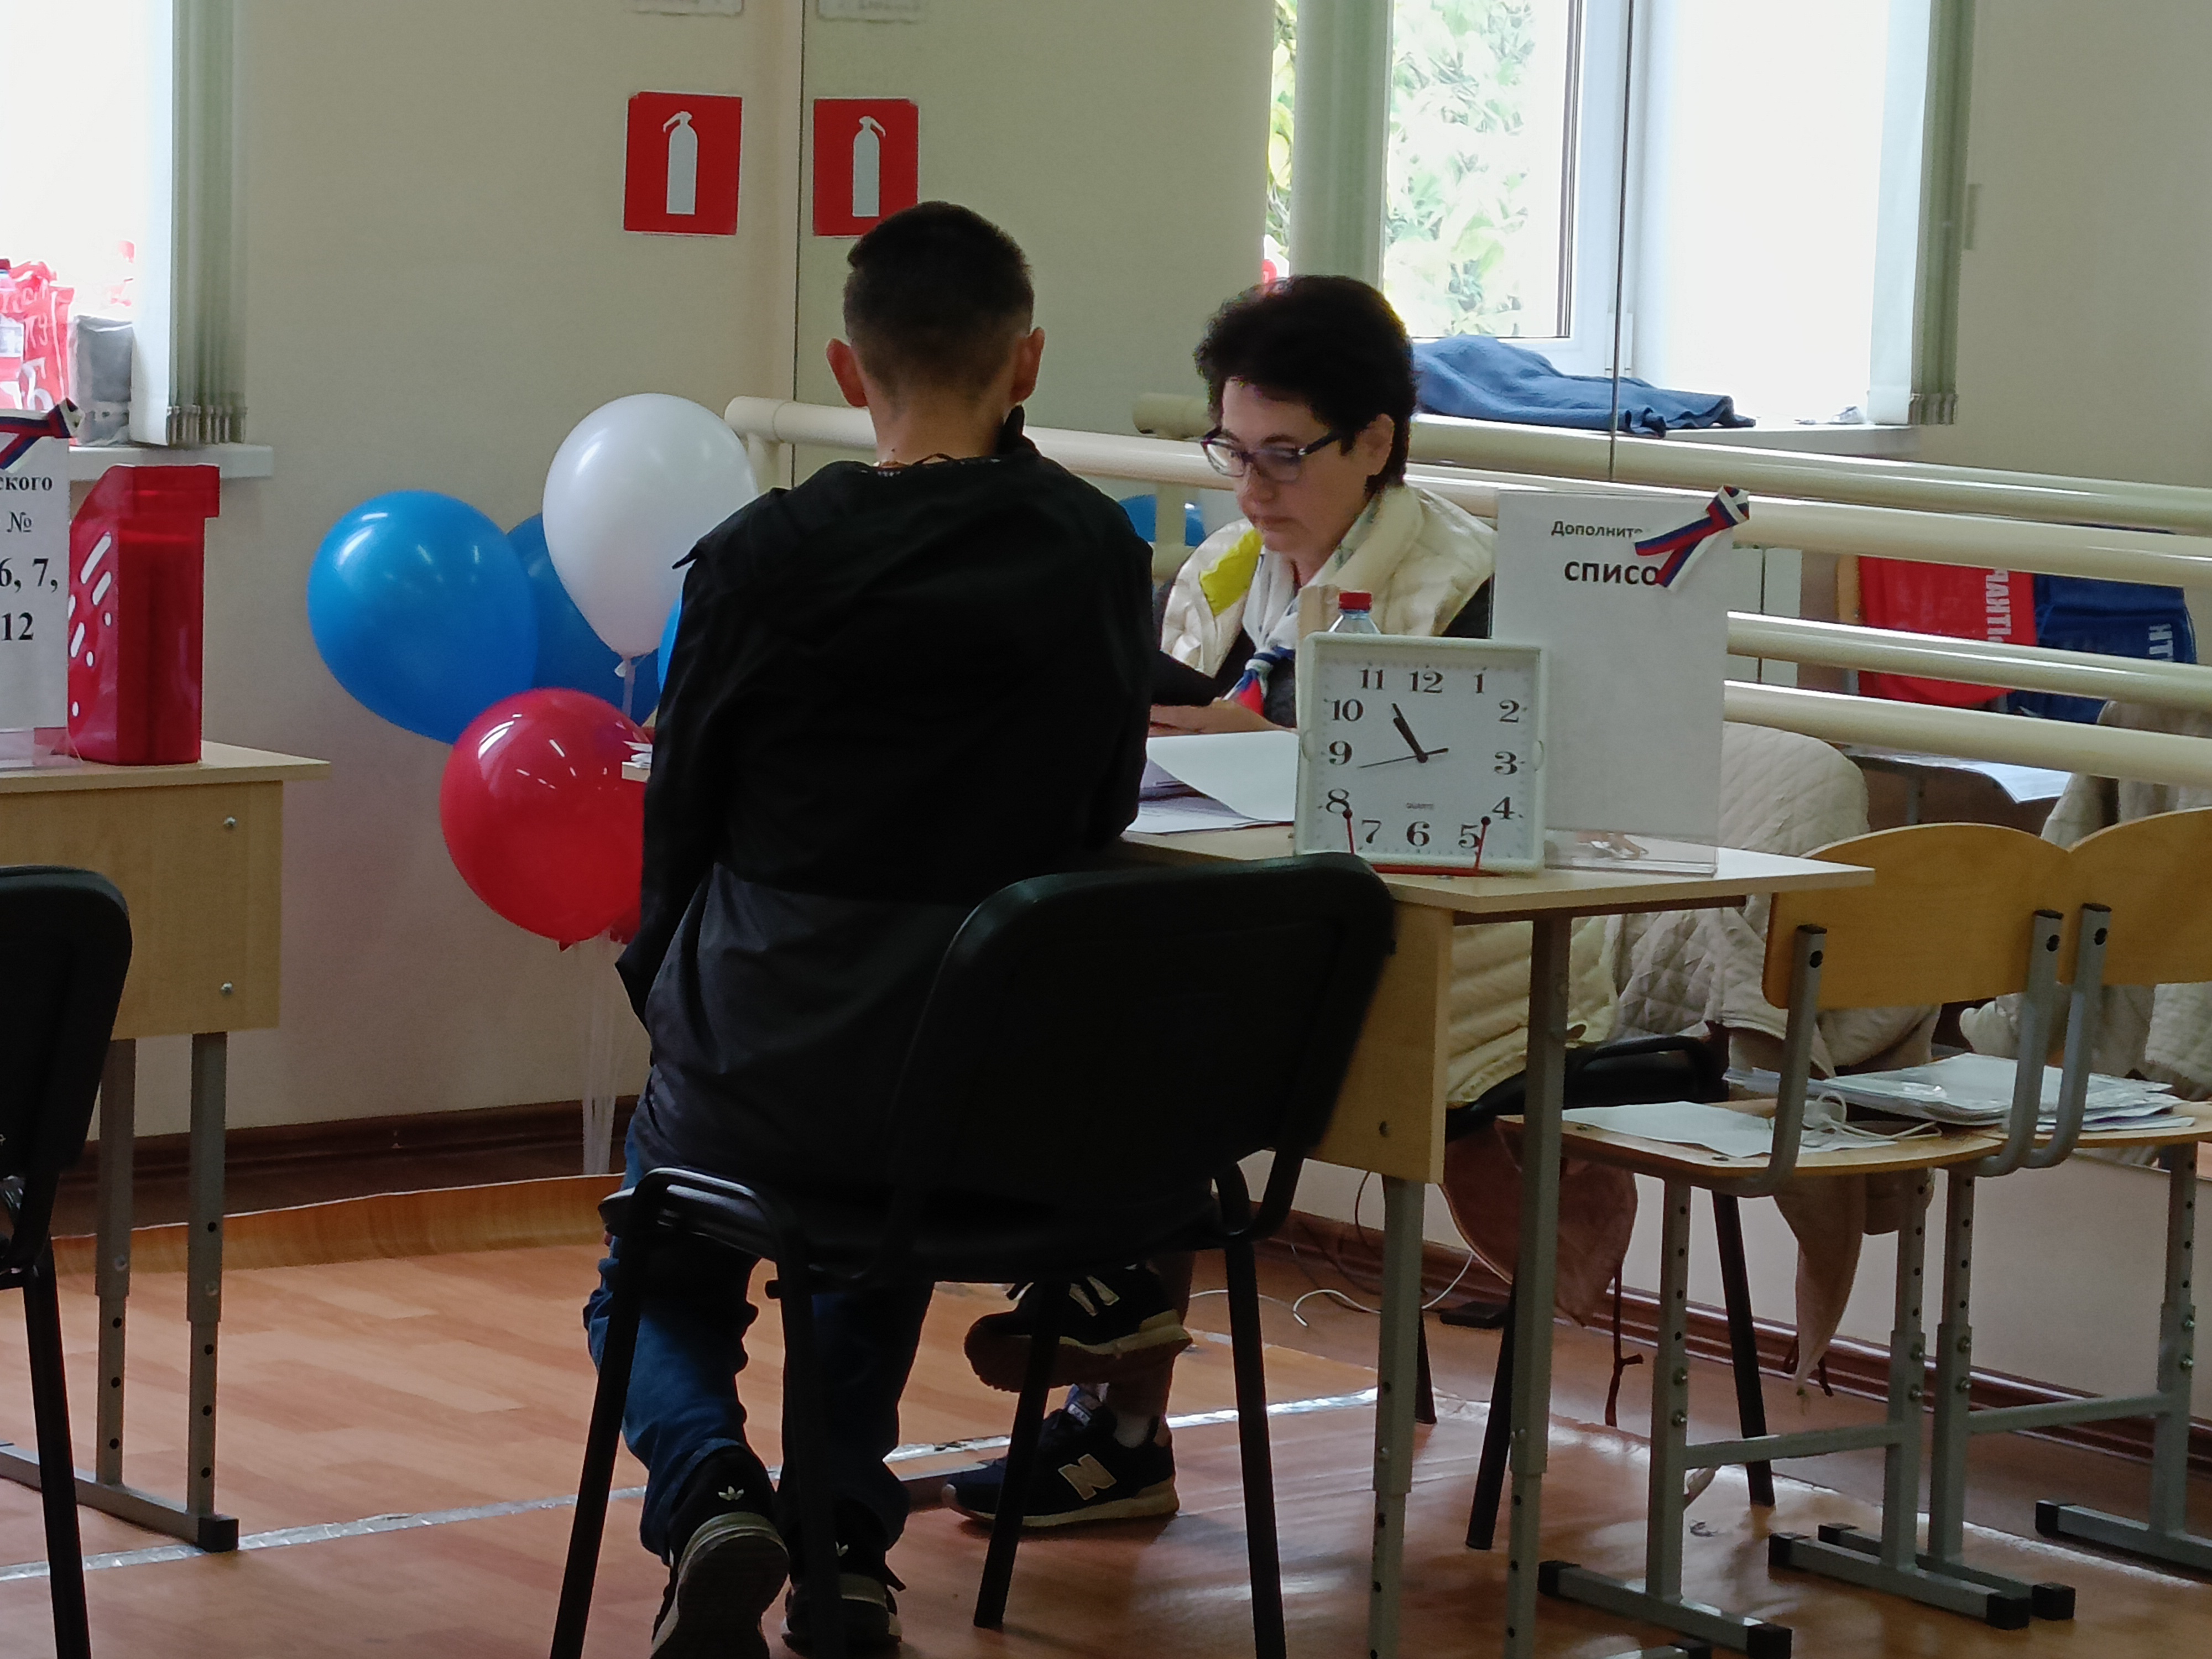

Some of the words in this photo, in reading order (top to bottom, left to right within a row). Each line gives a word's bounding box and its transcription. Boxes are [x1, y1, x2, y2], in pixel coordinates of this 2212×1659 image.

[6, 510, 32, 533] №
[0, 557, 22, 593] 6,
[32, 558, 58, 593] 7,
[1564, 561, 1661, 586] СПИСО
[1, 612, 34, 640] 12
[1360, 669, 1383, 690] 11
[1409, 670, 1443, 693] 12
[1474, 673, 1484, 693] 1
[1330, 698, 1364, 721] 10
[1499, 700, 1520, 723] 2
[1329, 740, 1353, 765] 9
[1494, 751, 1517, 775] 3
[1326, 789, 1350, 814] 8
[1492, 796, 1515, 820] 4
[1361, 820, 1381, 844] 7
[1406, 821, 1430, 847] 6
[1458, 824, 1481, 849] 5
